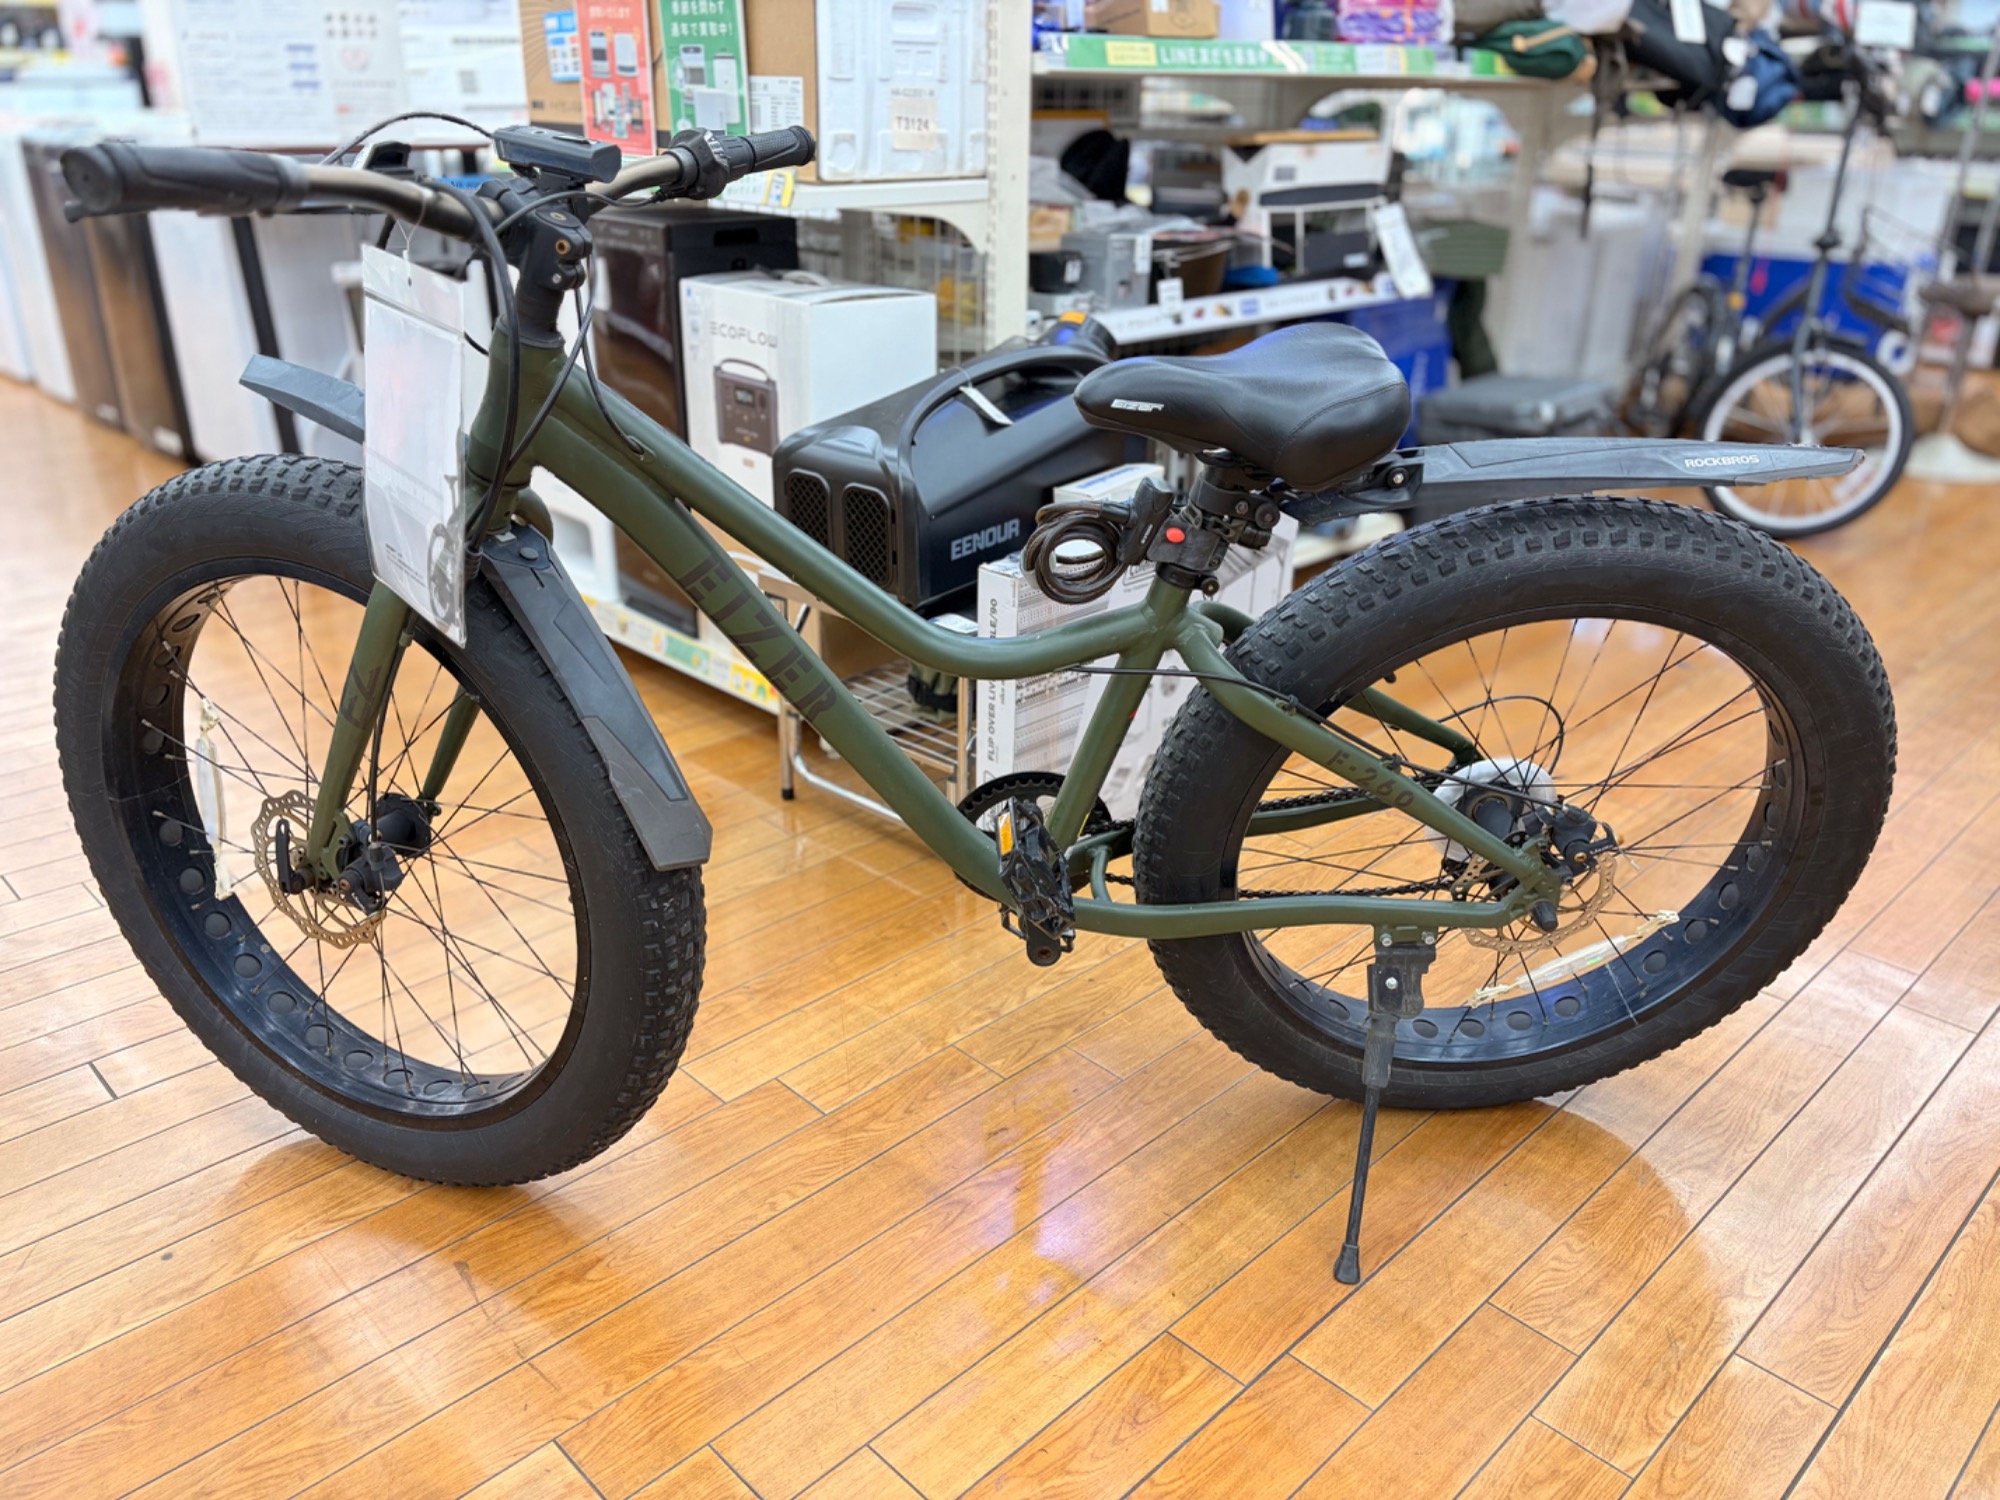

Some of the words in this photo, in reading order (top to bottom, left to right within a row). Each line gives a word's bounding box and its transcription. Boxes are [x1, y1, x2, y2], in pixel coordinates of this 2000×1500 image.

[896, 116, 930, 132] T3124
[709, 321, 778, 348] ECOFLOW
[1684, 454, 1760, 468] ROCKBROS
[950, 518, 1020, 561] EENOUR
[988, 703, 996, 735] OVER
[987, 736, 995, 762] FLIP
